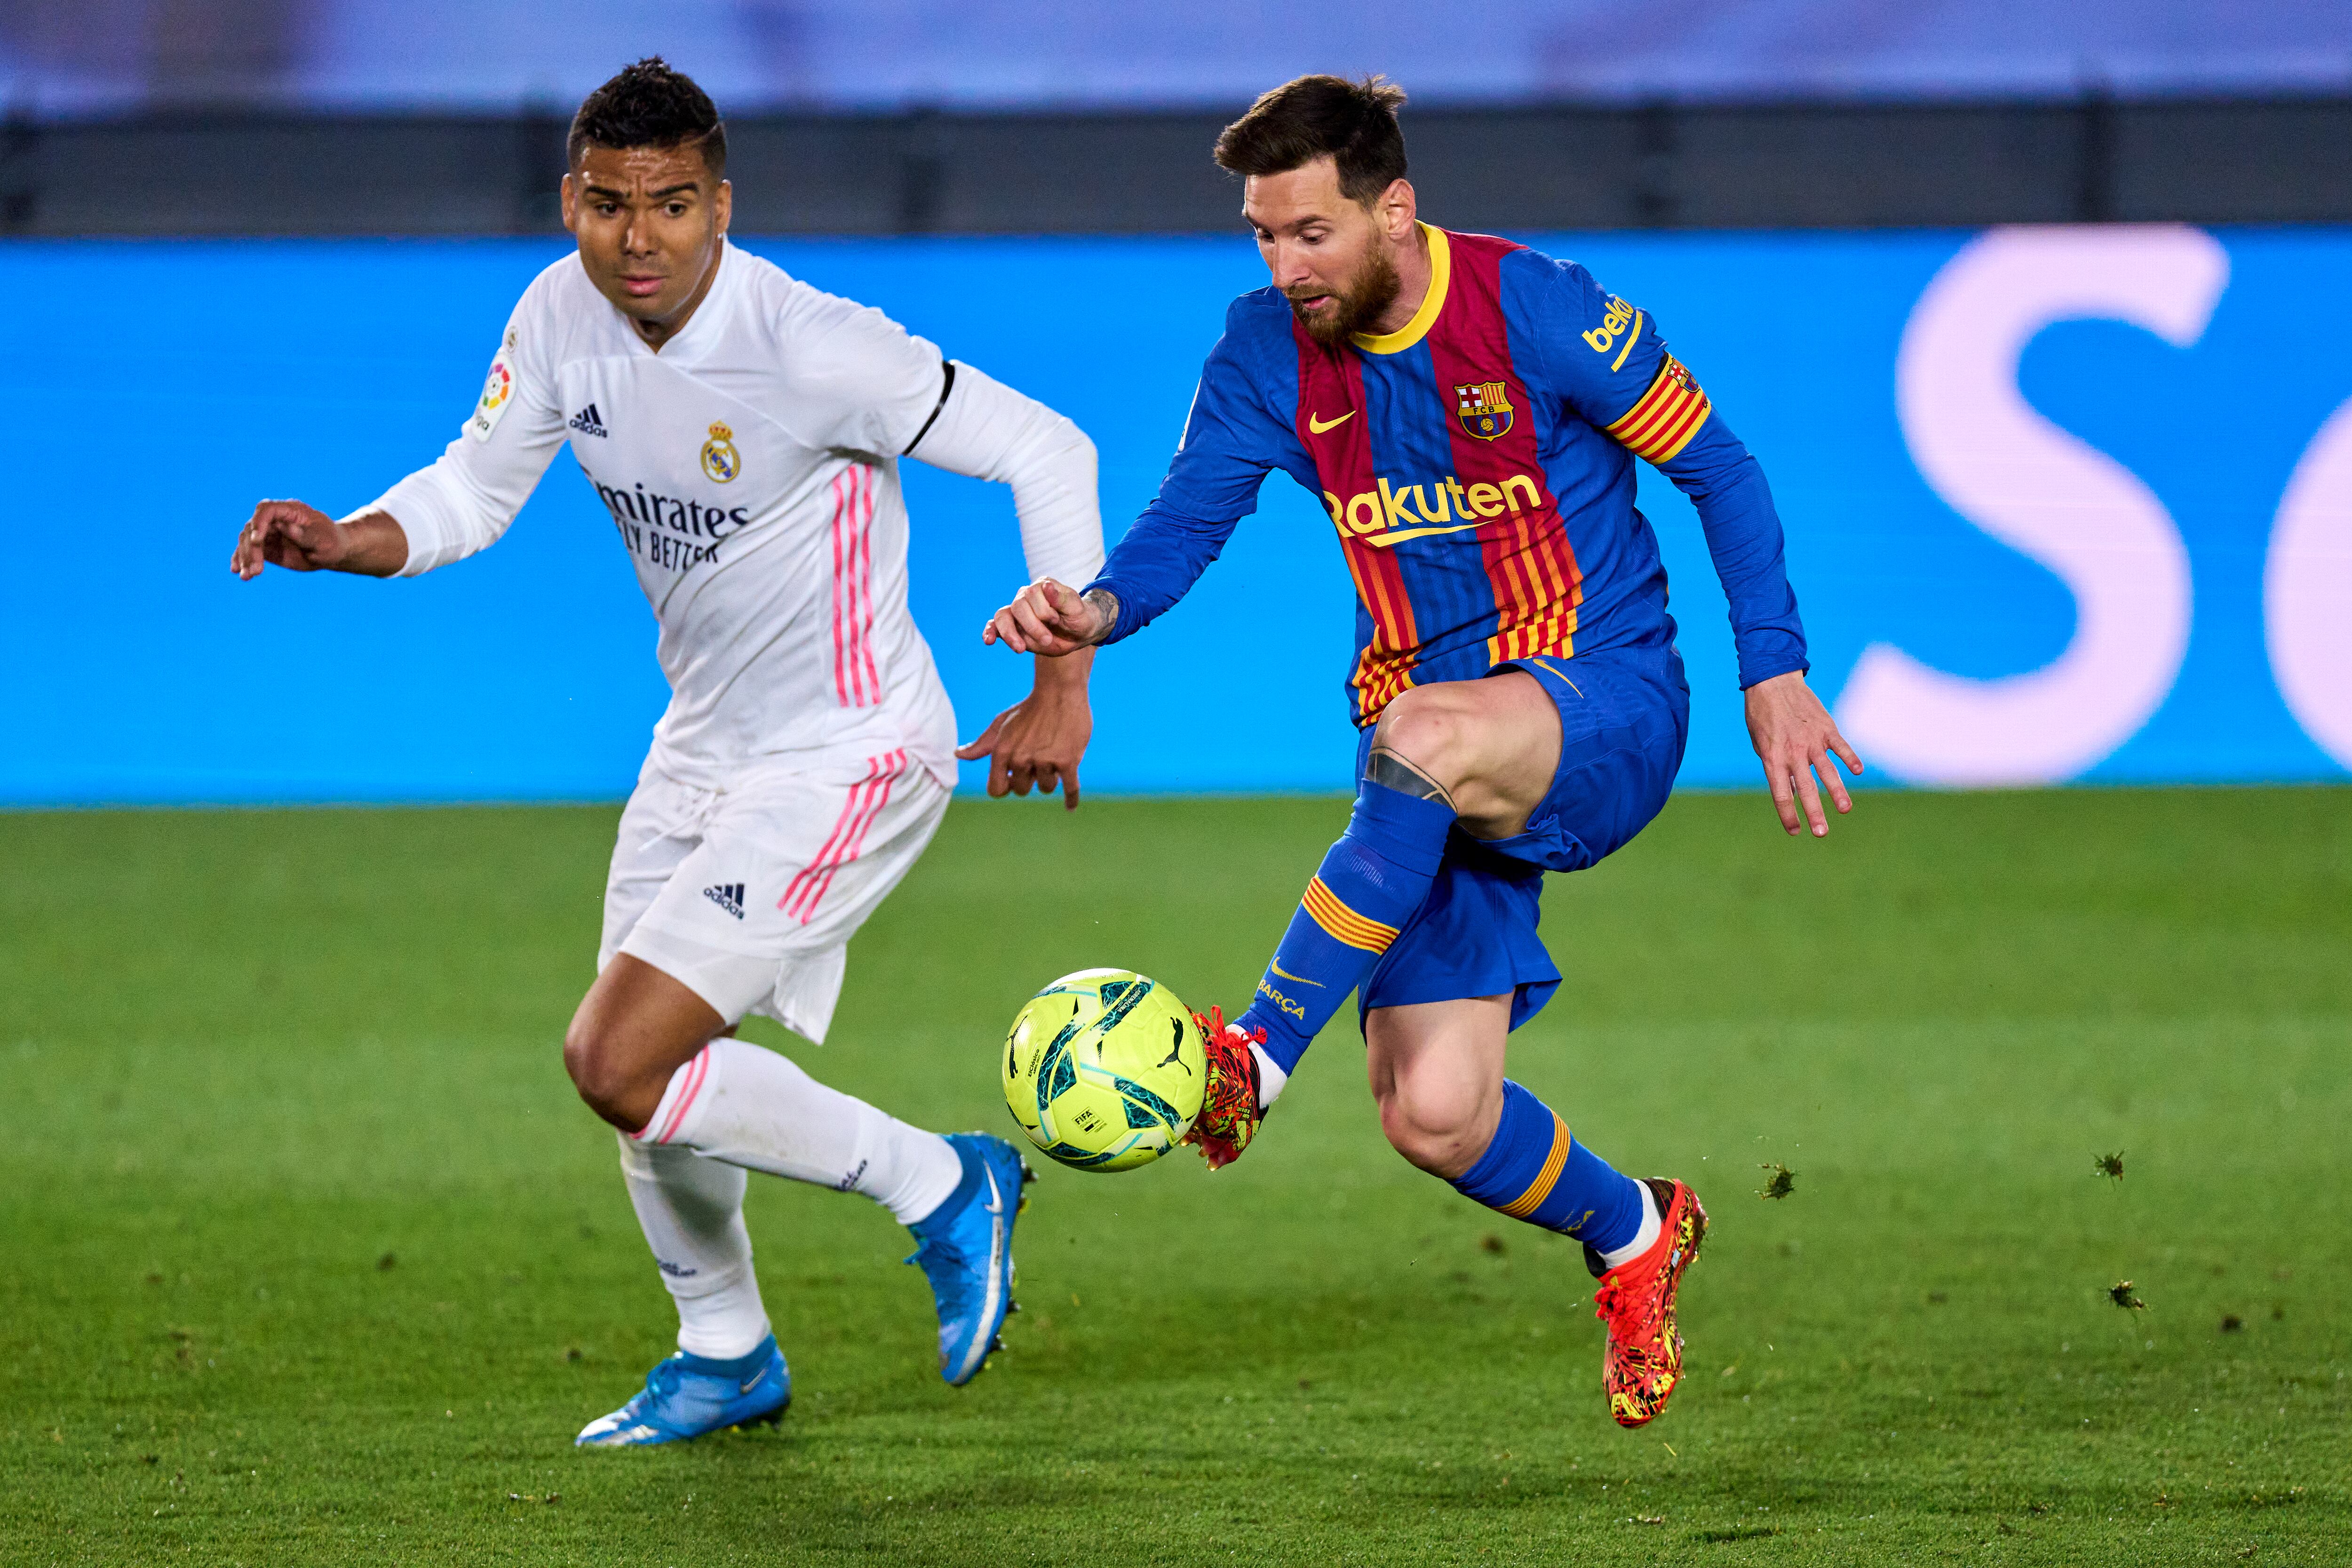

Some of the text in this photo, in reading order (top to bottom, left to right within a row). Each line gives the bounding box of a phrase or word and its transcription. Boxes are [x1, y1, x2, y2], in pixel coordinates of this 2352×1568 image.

[1581, 296, 1634, 353] beko
[569, 419, 608, 438] adidas
[1473, 406, 1495, 415] FCB
[580, 465, 750, 539] mirates
[1323, 474, 1542, 537] Rakuten
[1832, 222, 2352, 788] S
[704, 888, 744, 919] adidas
[1258, 979, 1305, 1020] BARÇA
[1075, 1111, 1093, 1125] FIFA
